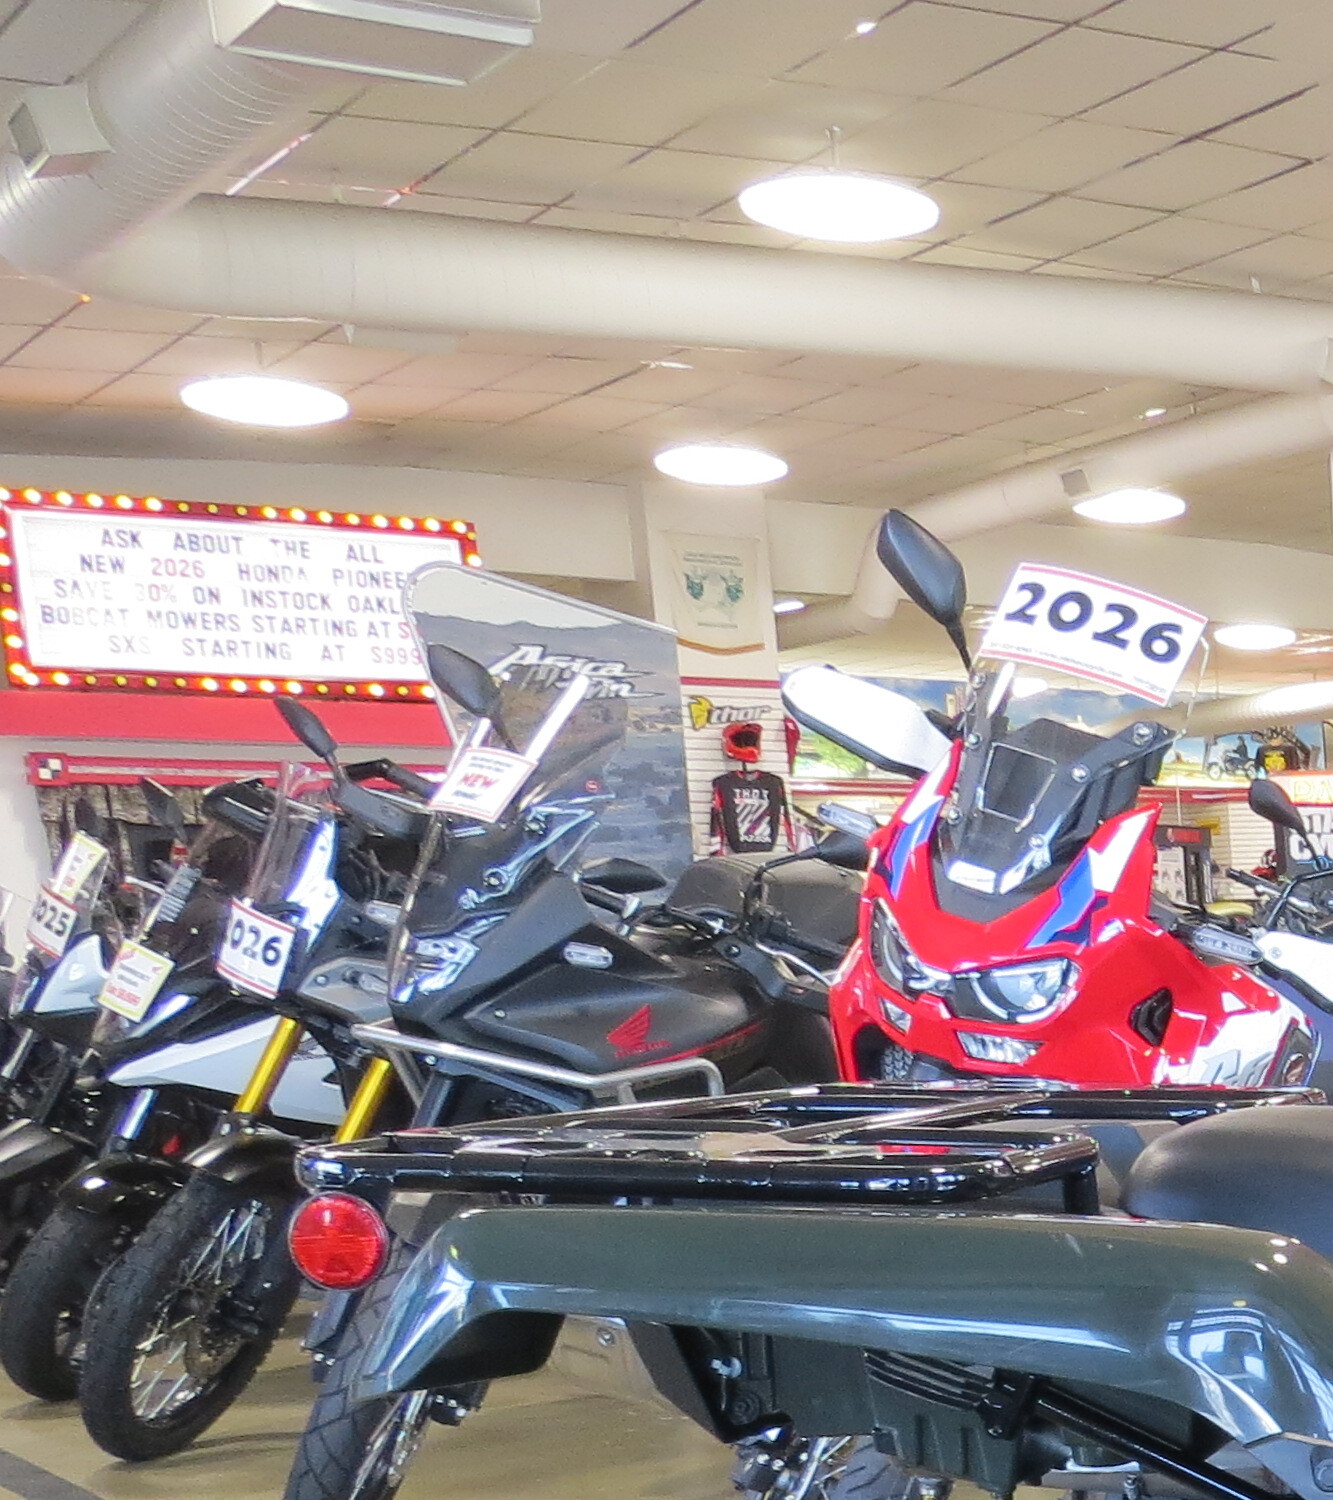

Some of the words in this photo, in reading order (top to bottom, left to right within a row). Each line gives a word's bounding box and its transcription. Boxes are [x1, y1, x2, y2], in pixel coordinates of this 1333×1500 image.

[101, 528, 143, 549] ASK
[173, 532, 244, 554] ABOUT
[269, 538, 311, 559] THE
[346, 544, 384, 564] ALL
[79, 554, 125, 574] NEW
[150, 557, 206, 579] 2026
[237, 563, 309, 585] HONDA
[53, 579, 112, 600] SAVE
[134, 583, 177, 603] 30%
[192, 586, 221, 606] ON
[241, 589, 332, 612] INSTOCK
[40, 604, 129, 626] BOBCAT
[147, 610, 241, 632] MOWERS
[252, 615, 358, 638] STARTING
[367, 621, 391, 639] AT
[1004, 582, 1184, 664] 2026
[108, 635, 151, 655] SXS
[181, 637, 292, 661] STARTING
[321, 645, 345, 662] AT
